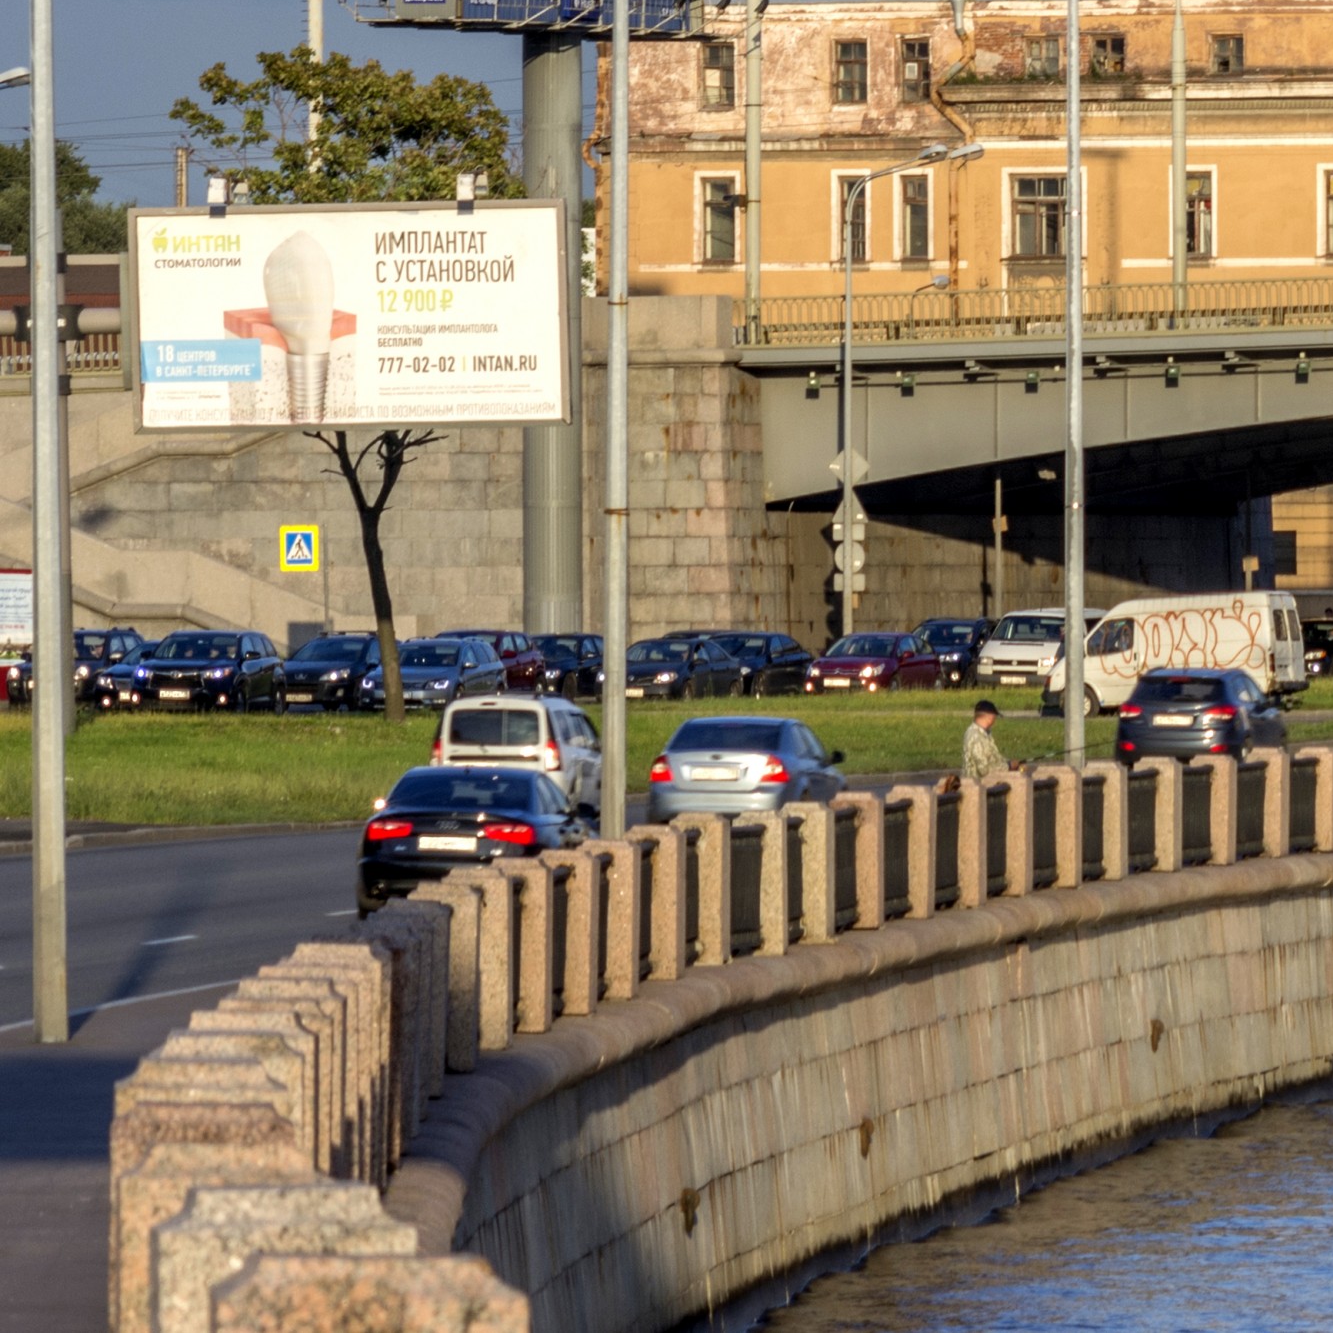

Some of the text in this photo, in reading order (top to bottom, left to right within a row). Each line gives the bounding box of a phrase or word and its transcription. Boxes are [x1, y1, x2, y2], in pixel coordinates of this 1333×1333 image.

[172, 234, 241, 254] ИНТАН
[375, 230, 487, 255] ИМПЛАНТАТ
[154, 257, 242, 269] СТОМАТОЛОГИИ
[375, 254, 515, 283] С УСТАНОВКОЙ
[377, 289, 397, 313] 12
[403, 289, 436, 313] 900
[377, 337, 423, 348] БЕСПЛАТНО
[157, 345, 174, 363] 18
[378, 355, 455, 374] 777-02-02
[473, 355, 538, 373] INTAN.RU
